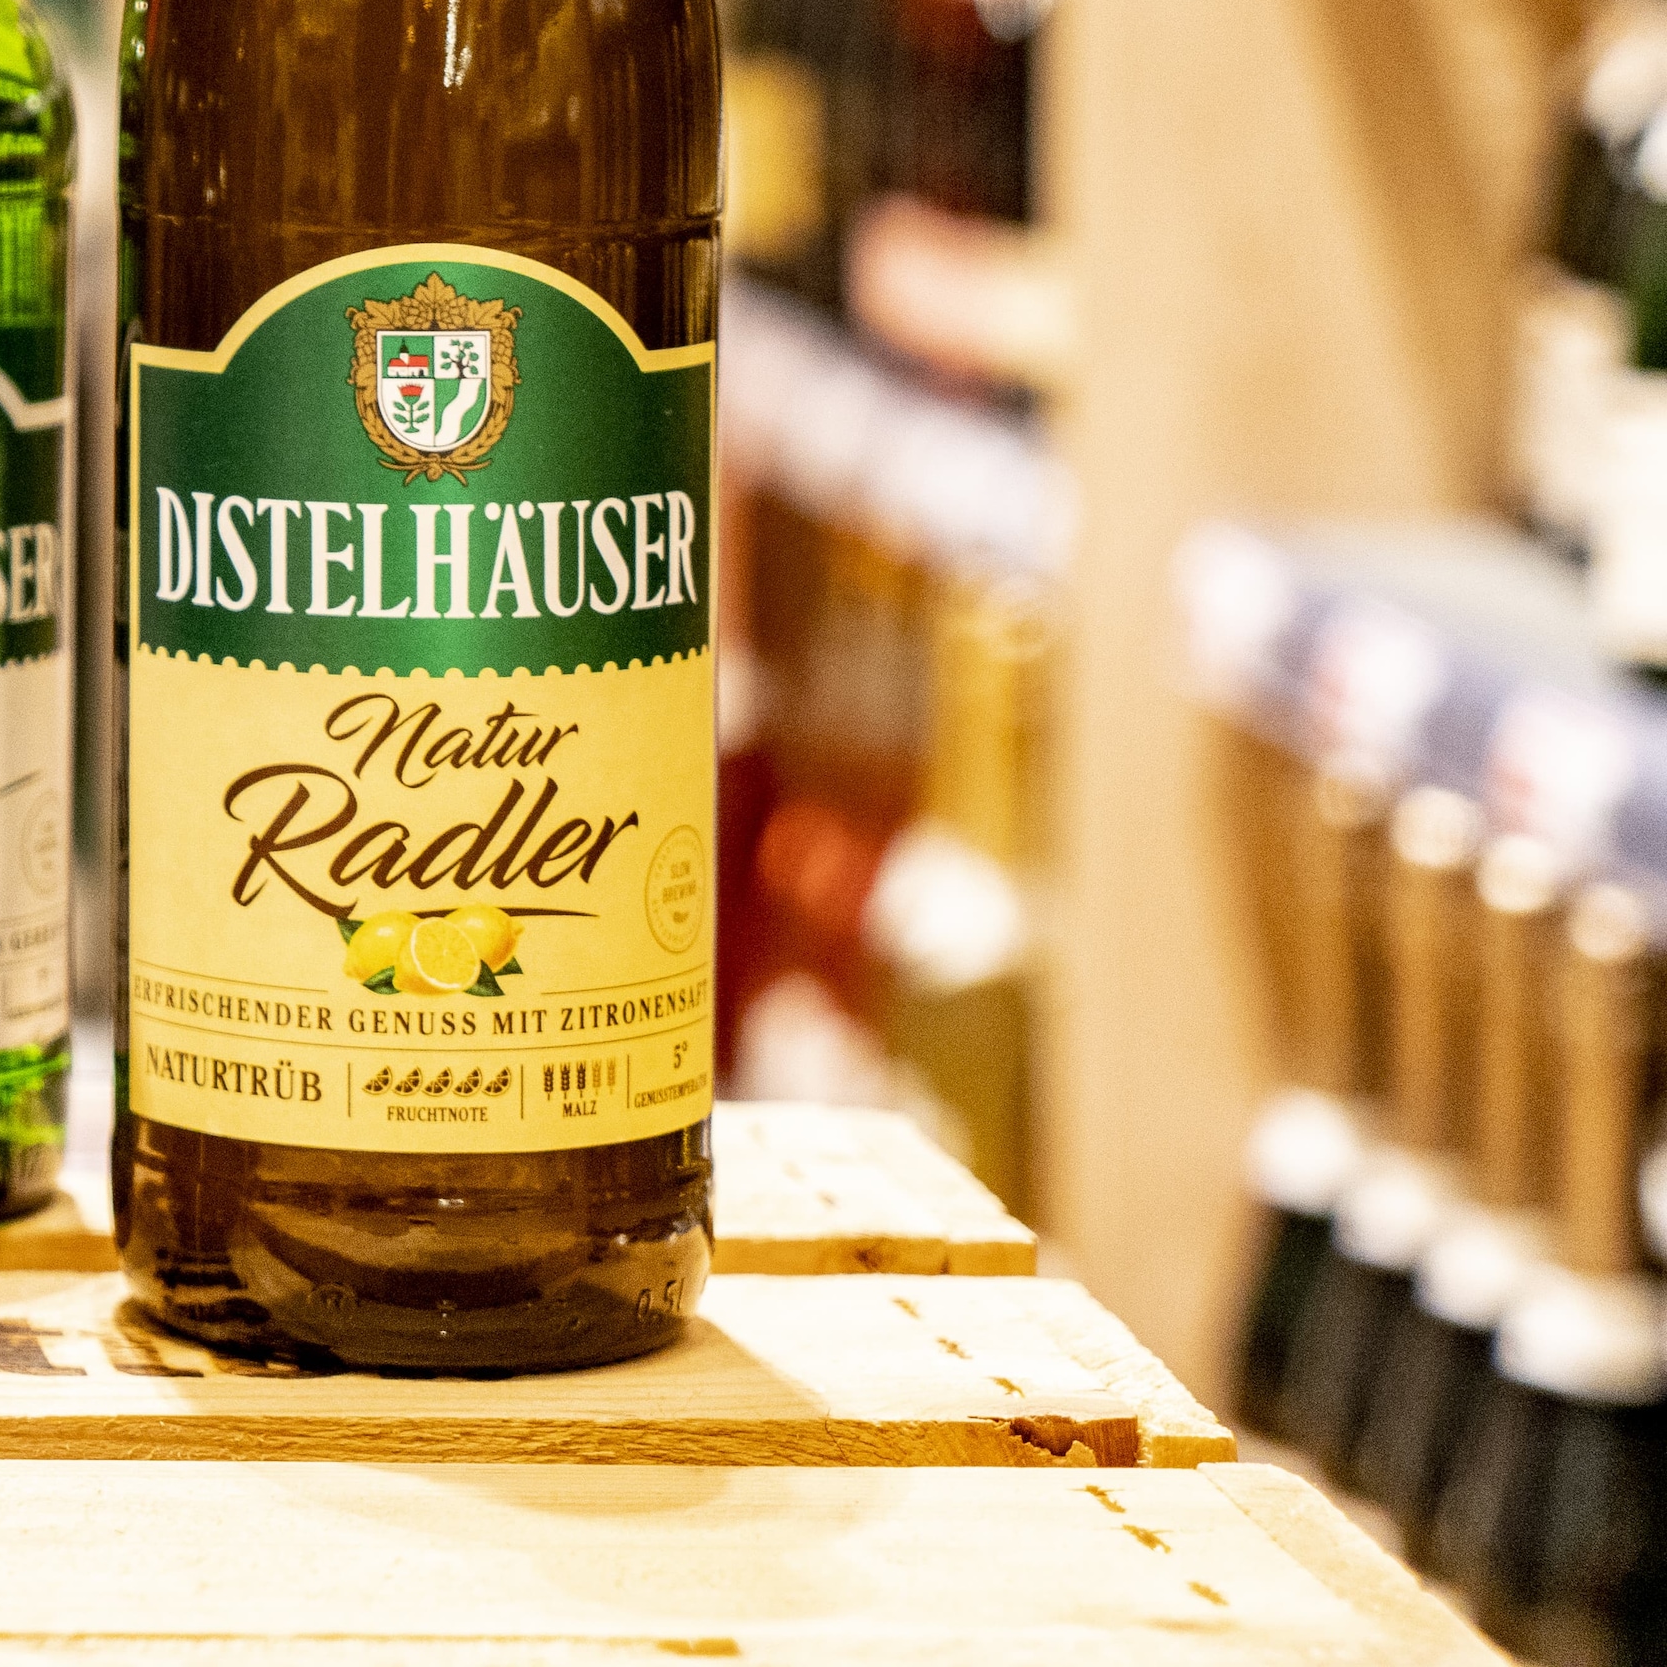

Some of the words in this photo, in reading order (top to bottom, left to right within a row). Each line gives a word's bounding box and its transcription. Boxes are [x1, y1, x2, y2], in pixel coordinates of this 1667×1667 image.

[155, 485, 699, 621] DISTELHÄUSER
[325, 692, 579, 789] Natur
[224, 763, 639, 918] Radler
[134, 974, 333, 1030] ERFRISCHENDER
[348, 1008, 476, 1035] GENUSS
[493, 1009, 547, 1034] MIT
[146, 1042, 323, 1102] NATURTRÜB
[387, 1106, 488, 1122] FRUCHTNOTE
[562, 1100, 597, 1118] MALZ
